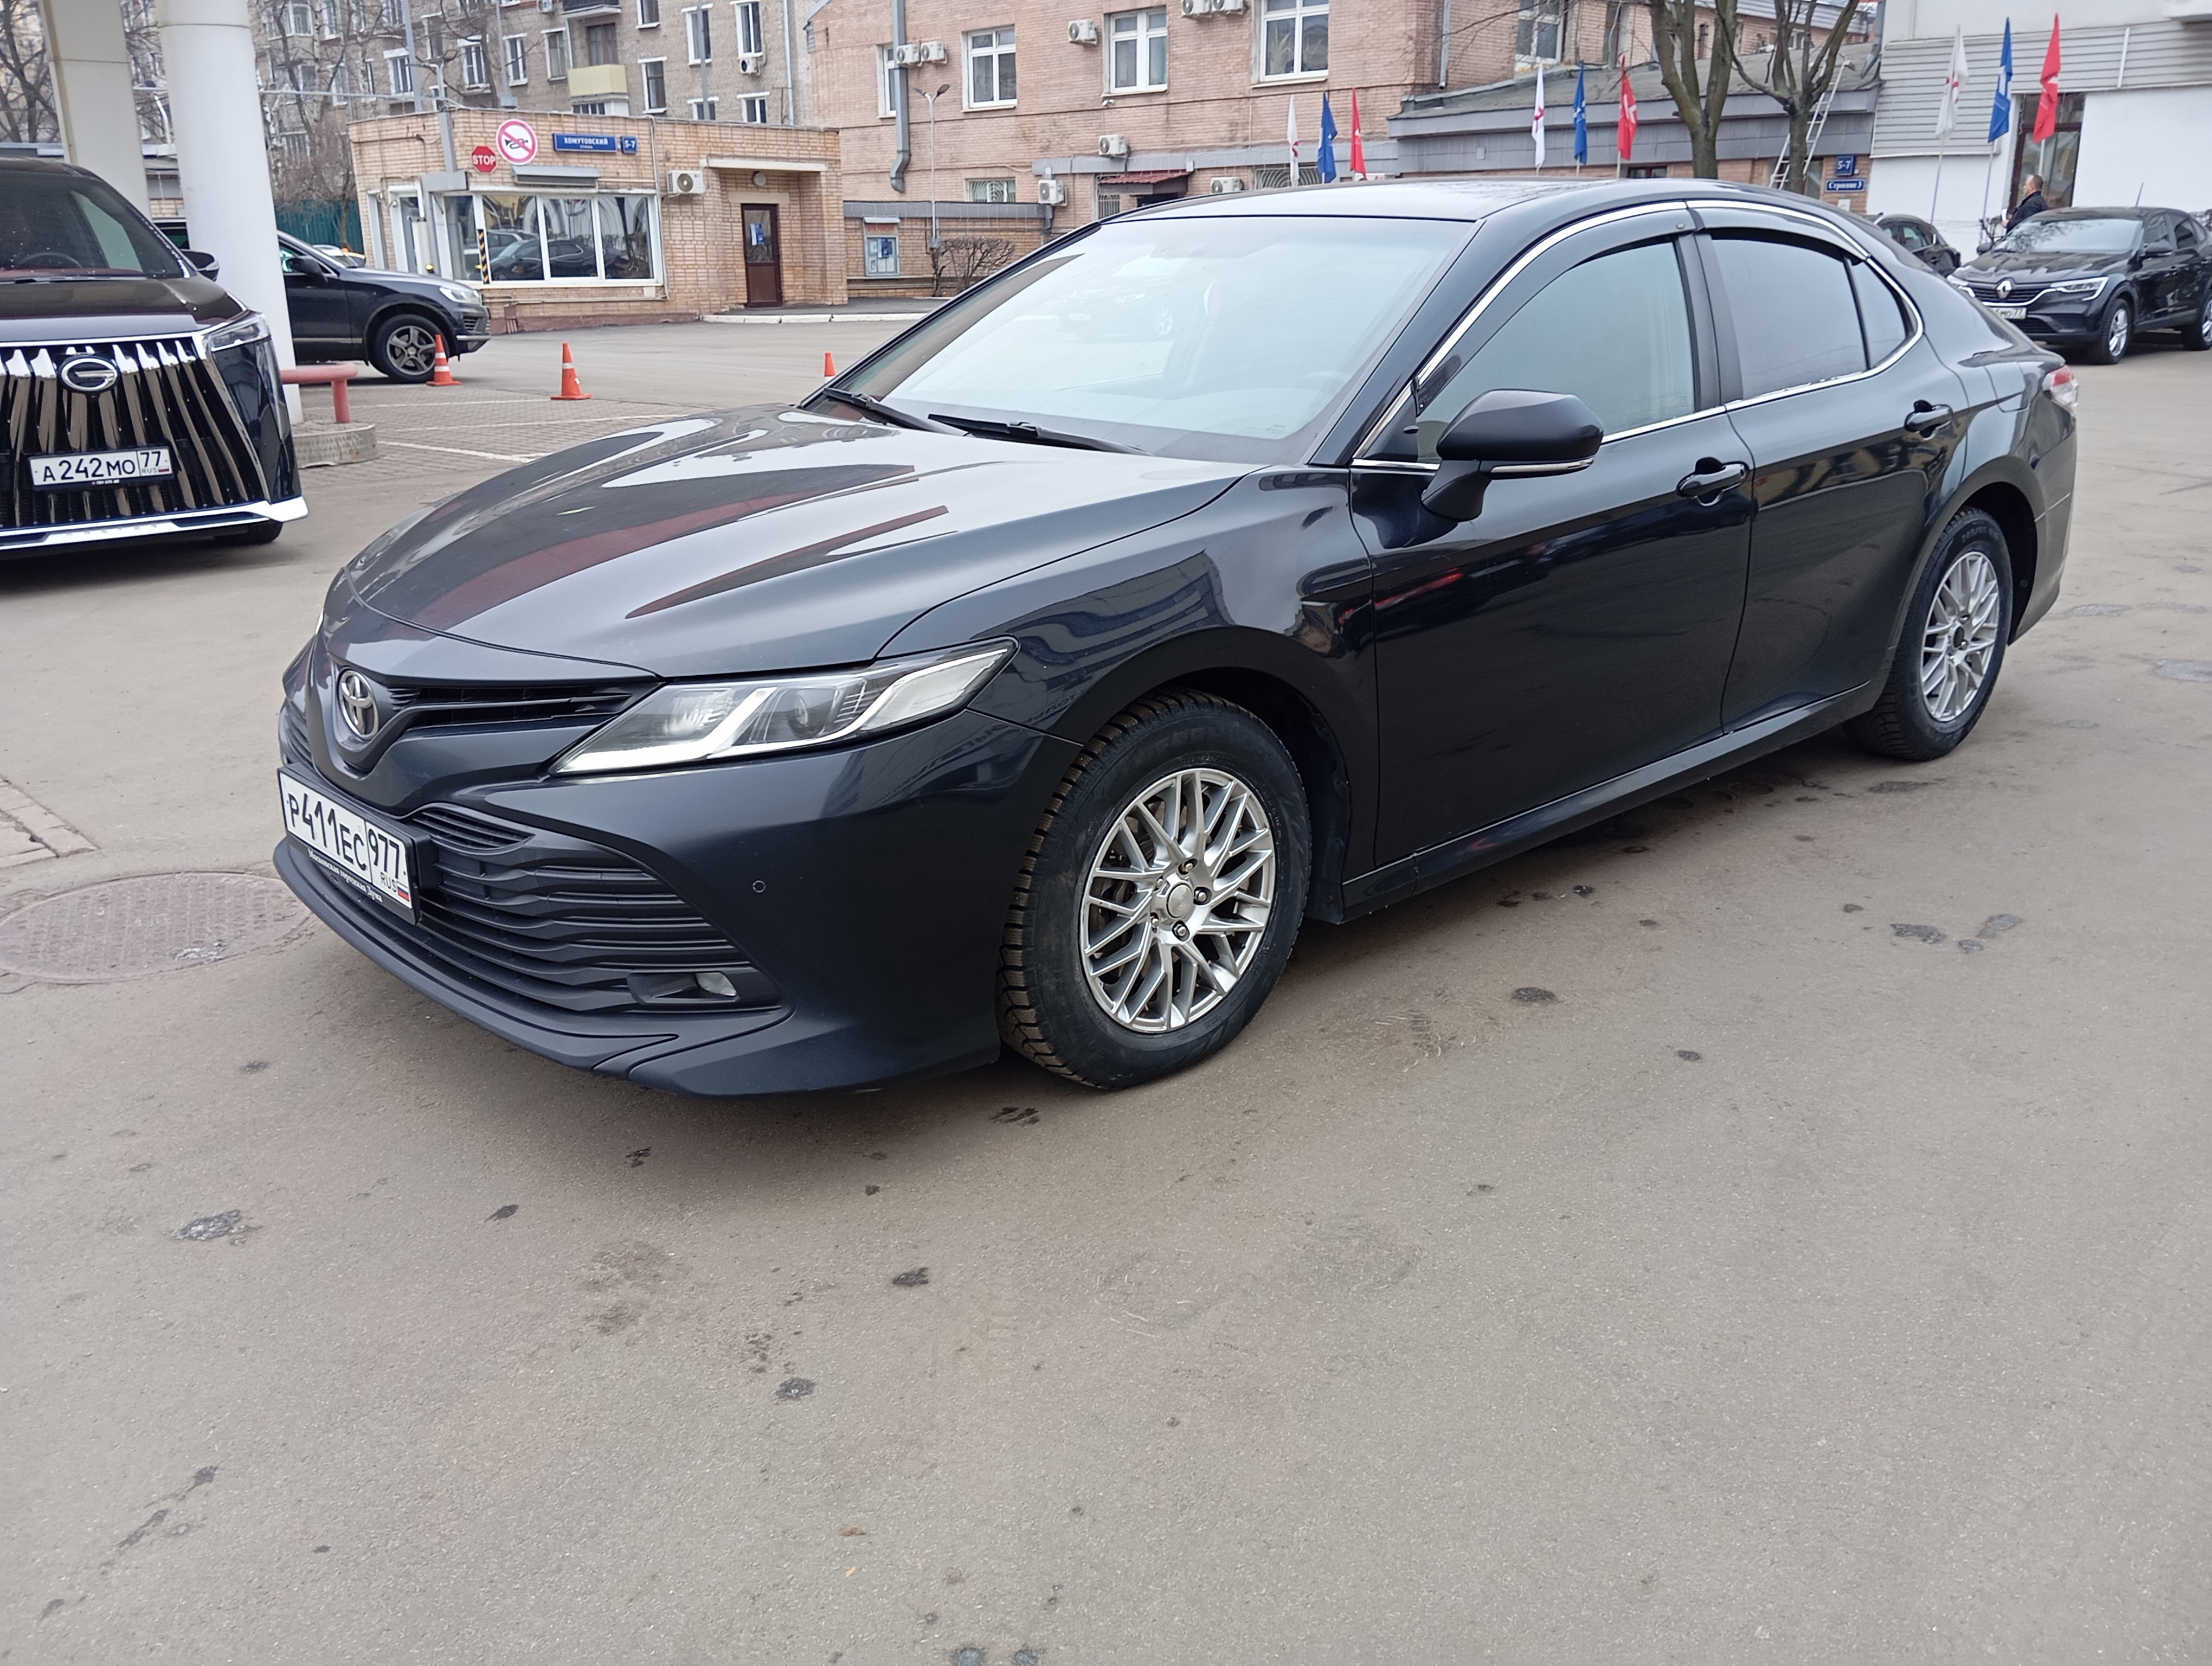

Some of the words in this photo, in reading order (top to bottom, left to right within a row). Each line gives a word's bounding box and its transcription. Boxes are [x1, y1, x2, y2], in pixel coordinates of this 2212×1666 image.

[564, 137, 608, 145] ХОМУТОВСКИЙ
[625, 139, 635, 148] 5-7
[472, 155, 496, 165] STOP
[1836, 160, 1851, 170] 5-7
[43, 458, 136, 482] А242МО
[140, 451, 161, 467] 77
[288, 793, 367, 871] Р411ЕС
[368, 828, 399, 879] 977
[381, 872, 397, 893] RUS
